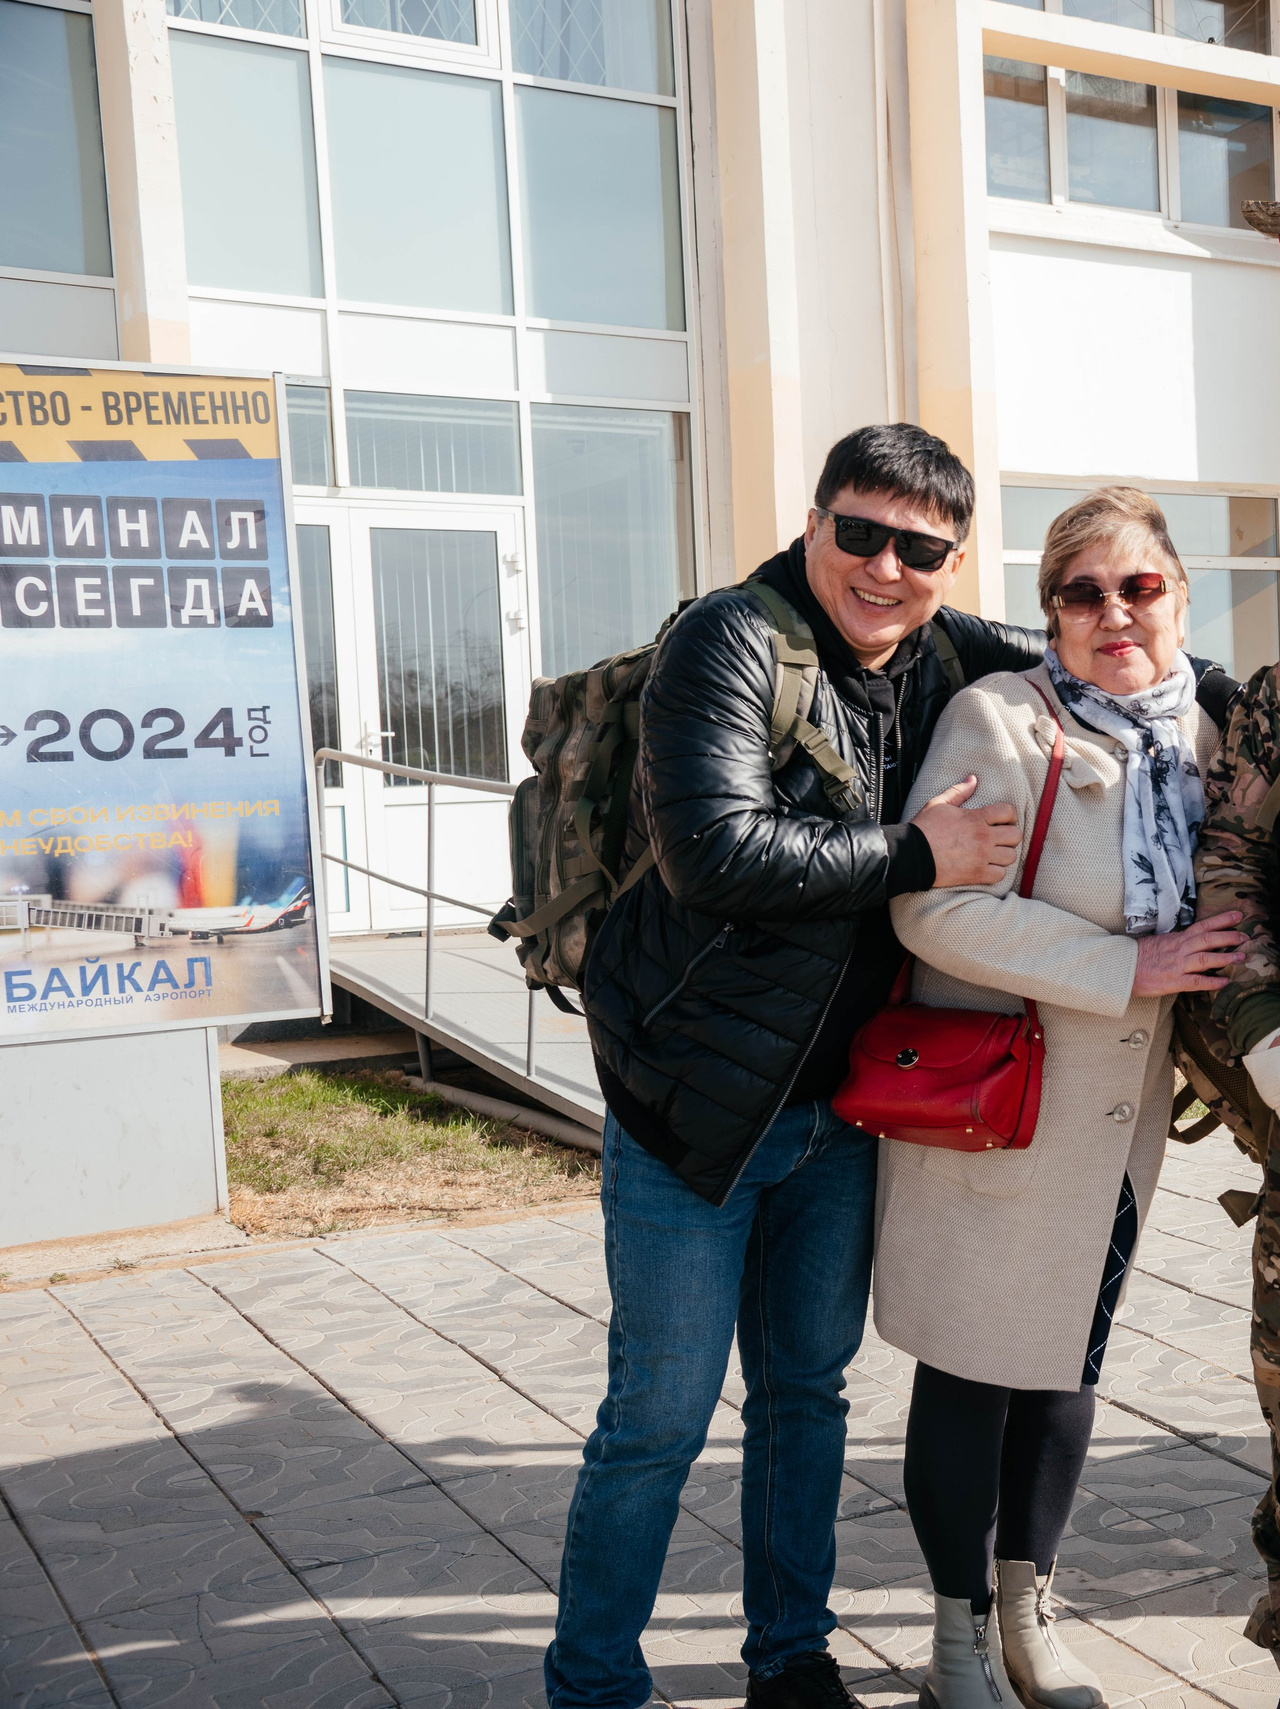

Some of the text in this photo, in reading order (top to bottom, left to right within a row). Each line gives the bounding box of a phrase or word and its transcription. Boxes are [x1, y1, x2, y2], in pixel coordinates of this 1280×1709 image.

[102, 390, 271, 426] ВРЕМЕННО
[1, 505, 258, 549] МИНАЛ
[15, 576, 268, 625] СЕГДА
[24, 705, 271, 763] 2024 ГОД
[0, 800, 280, 827] М СВОИ ИЗВИНЕНИЯ
[0, 831, 194, 857] НЕУДОБСТВА!
[4, 956, 213, 1003] БАЙКАЛ
[7, 988, 213, 1014] МЕЖДУНАРОДНЫЙ АЭРОПОРТ
